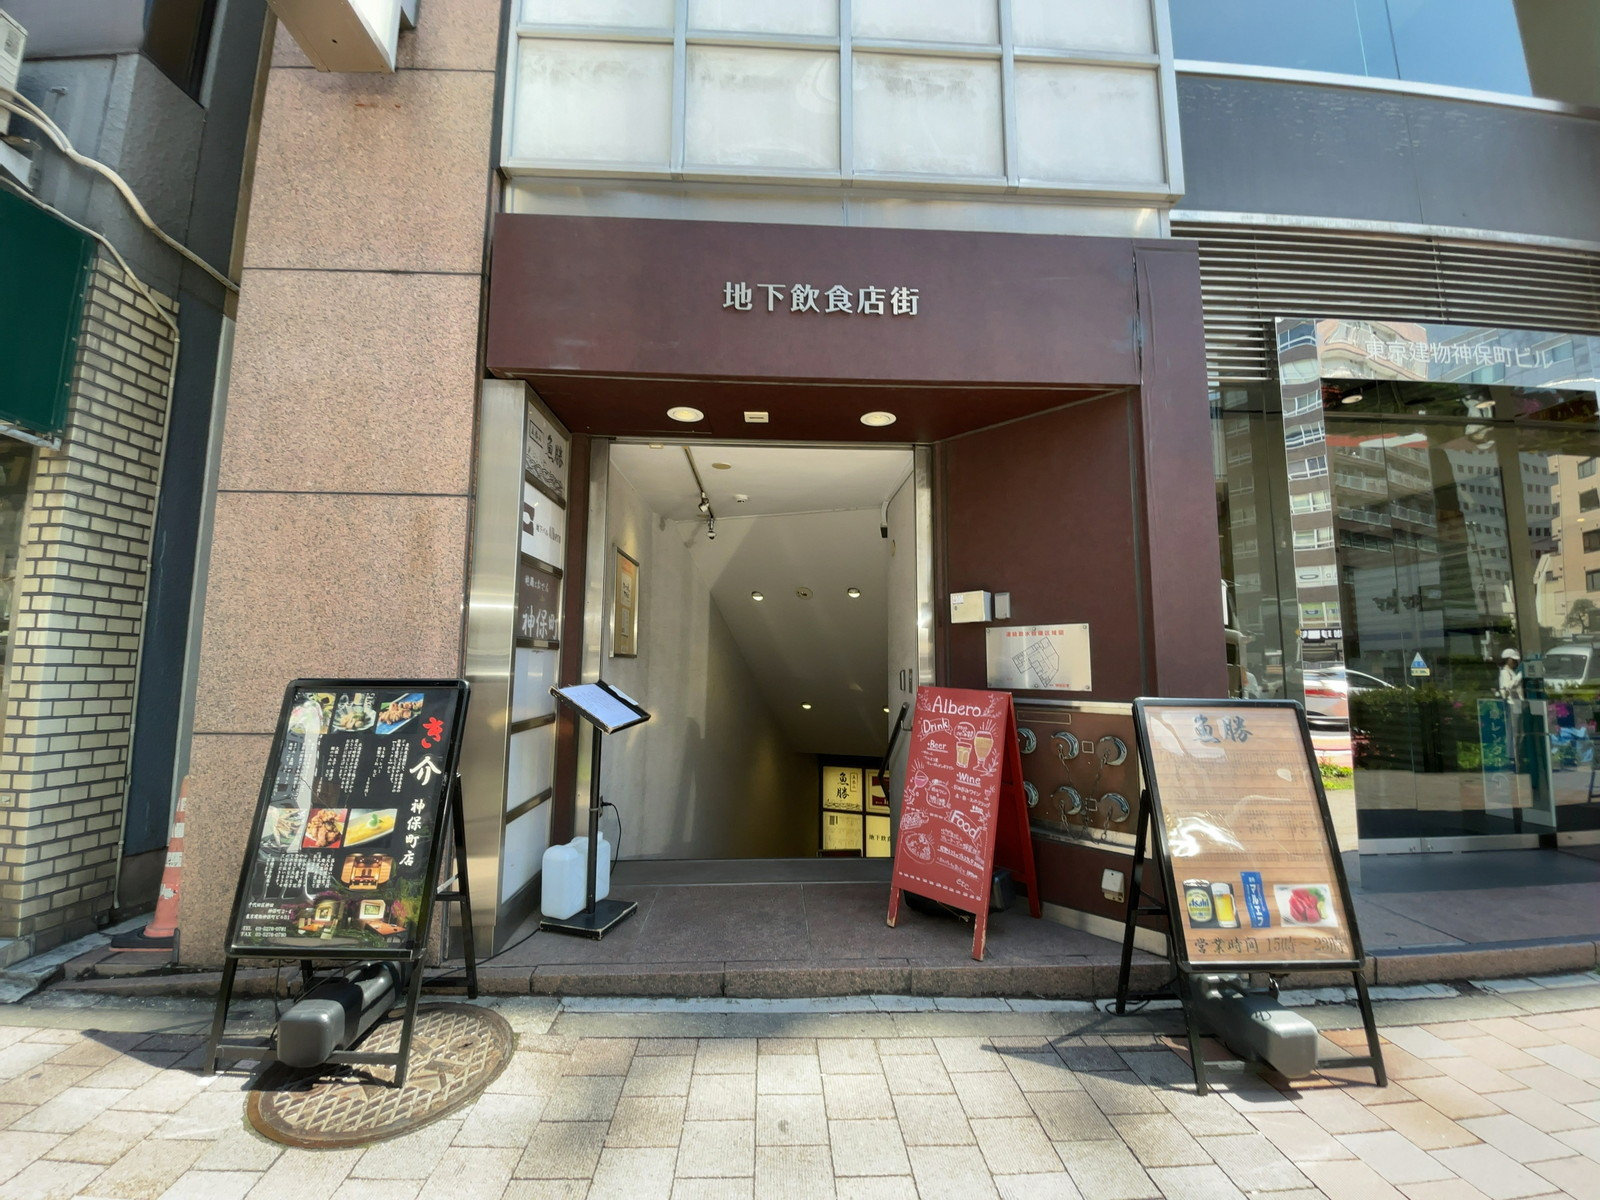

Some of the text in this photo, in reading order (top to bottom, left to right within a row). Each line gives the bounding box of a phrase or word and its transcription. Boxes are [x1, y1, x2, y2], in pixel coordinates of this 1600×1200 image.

[723, 281, 919, 316] 地下飲食店街
[1365, 340, 1553, 369] 東京建物神保町ビル
[522, 605, 558, 640] 神保町
[931, 696, 981, 717] Albero
[923, 718, 948, 733] Drink
[1193, 714, 1253, 744] 魚勝
[836, 771, 850, 799] 魚勝
[958, 771, 981, 785] Wine
[399, 799, 425, 866] 神保町店
[950, 810, 980, 839] Food
[1188, 898, 1210, 907] Asahi
[1193, 936, 1259, 954] 営業時間
